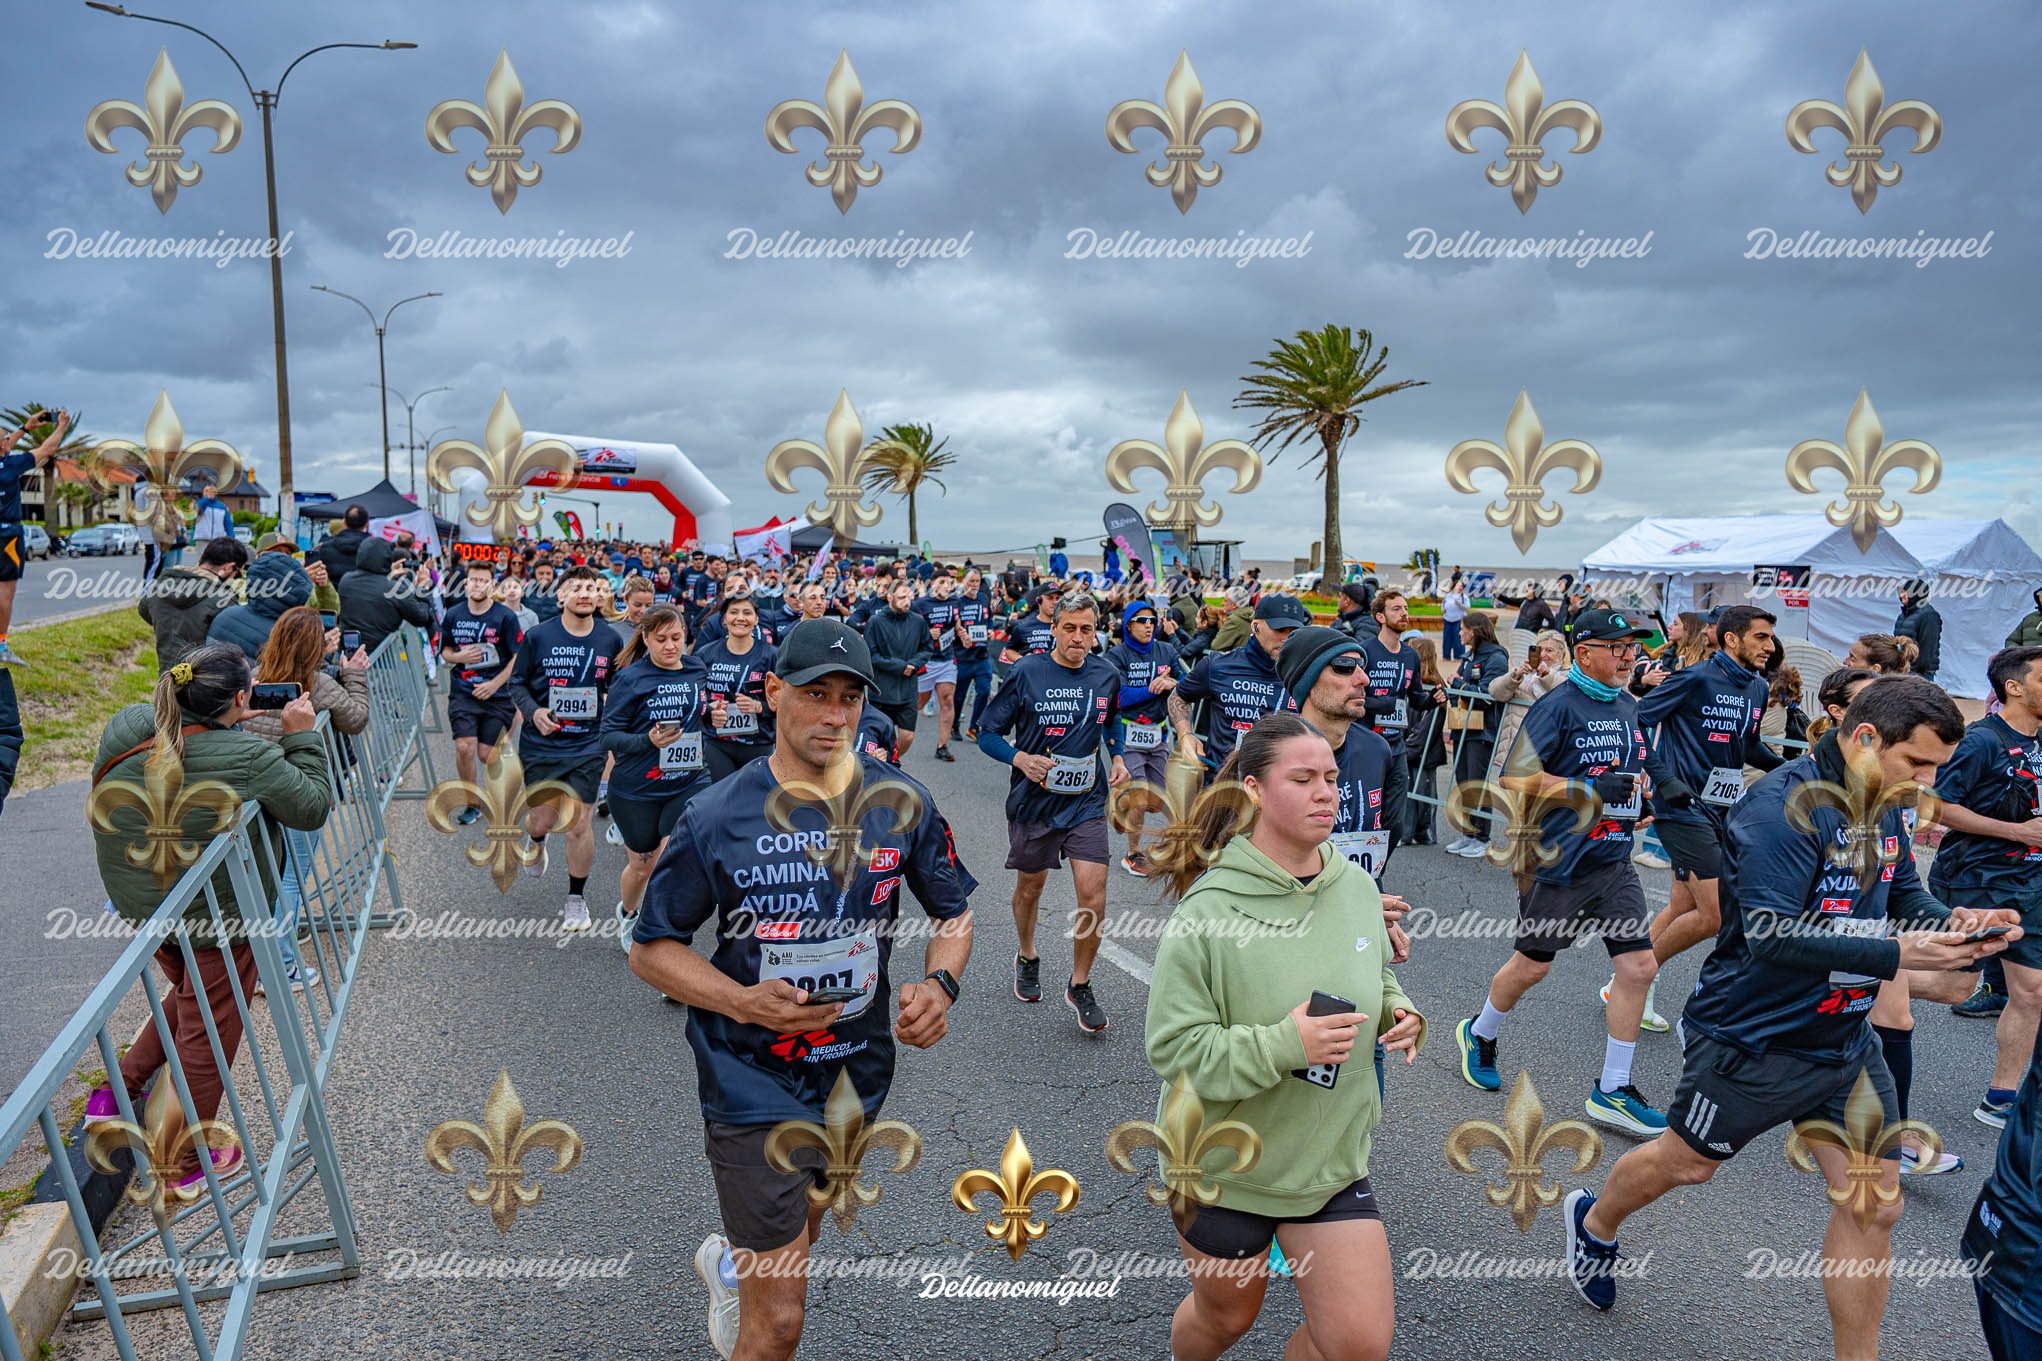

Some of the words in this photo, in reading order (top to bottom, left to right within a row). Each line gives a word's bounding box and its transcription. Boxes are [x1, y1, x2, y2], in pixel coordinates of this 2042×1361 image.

[551, 645, 585, 656] CORRÉ
[711, 663, 741, 672] CORRÉ
[1369, 669, 1396, 678] CAMINÁ
[657, 682, 691, 694] CORRÉ
[1233, 679, 1274, 695] CORRÉ
[1370, 678, 1393, 687] AYUDÁ
[1046, 687, 1083, 698] CORRÉ
[556, 699, 587, 713] 2994
[647, 694, 689, 707] CAMINÁ
[1035, 699, 1080, 712] CAMINÁ
[1220, 693, 1268, 708] CAMINÁ
[1716, 694, 1744, 707] CORRÉ
[649, 707, 684, 720] AYUDÁ
[1039, 713, 1074, 725] AYUDÁ
[1225, 707, 1260, 720] AYUDÁ
[1702, 706, 1741, 719] CAMINÁ
[1588, 719, 1622, 732] CORRÉ
[1702, 719, 1737, 731] AYUDÁ
[1131, 731, 1155, 744] 2653
[1575, 732, 1623, 749] CAMINÁ
[667, 746, 697, 763] 2993
[1580, 748, 1620, 764] AYUDÁ
[1055, 769, 1088, 787] 2362
[1711, 781, 1739, 799] 2105
[756, 826, 839, 855] CORRÉ
[875, 851, 895, 868] 5K
[733, 856, 829, 888] CAMINÁ
[739, 888, 819, 914] AYUDÁ
[820, 1040, 868, 1061] FRONTERAS
